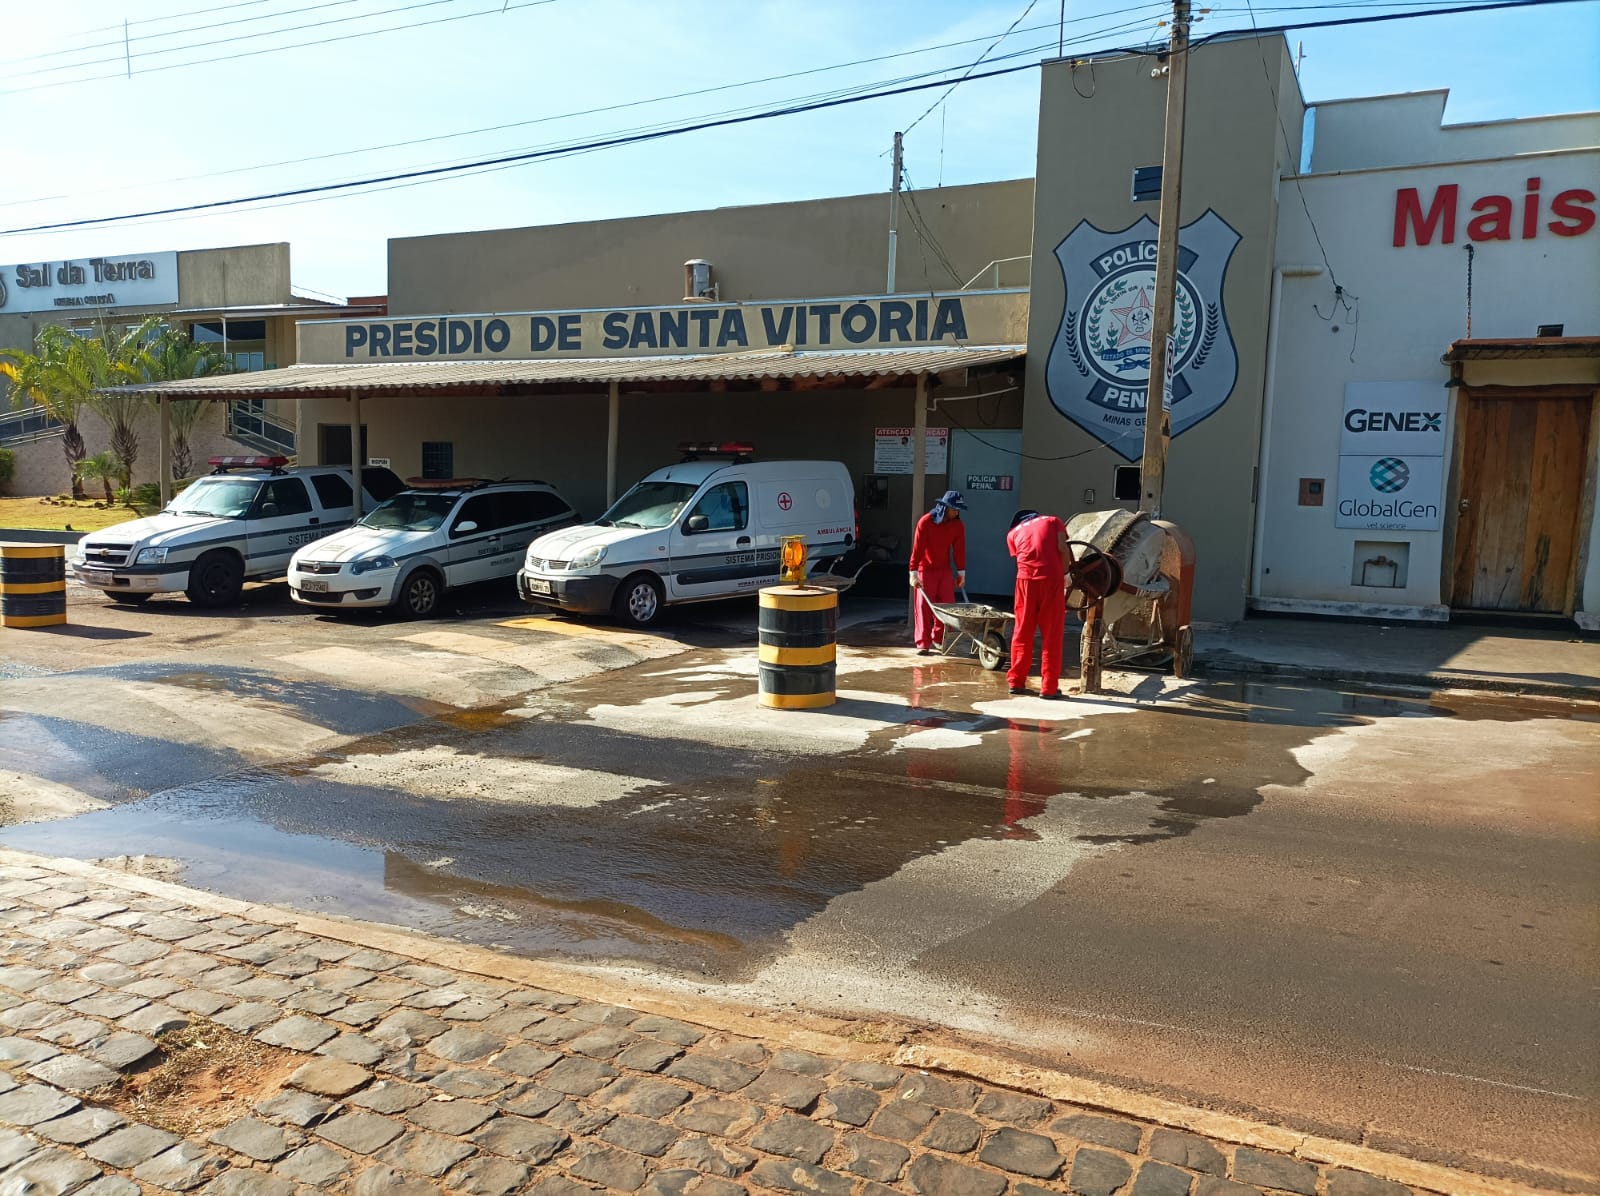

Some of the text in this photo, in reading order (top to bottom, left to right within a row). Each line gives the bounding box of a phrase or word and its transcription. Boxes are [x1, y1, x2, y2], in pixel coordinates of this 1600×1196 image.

[1392, 176, 1597, 248] Mais
[1098, 241, 1158, 273] POLÍC
[15, 256, 156, 289] Sal da Terra
[345, 298, 969, 358] PRESÍDIO DE SANTA VITÓRIA
[1102, 387, 1145, 409] PEN
[1102, 413, 1132, 426] MINAS
[1344, 408, 1442, 433] GENEX
[971, 482, 993, 490] PENAL
[1338, 498, 1438, 518] GlobalGen
[725, 553, 755, 565] SISTEMA
